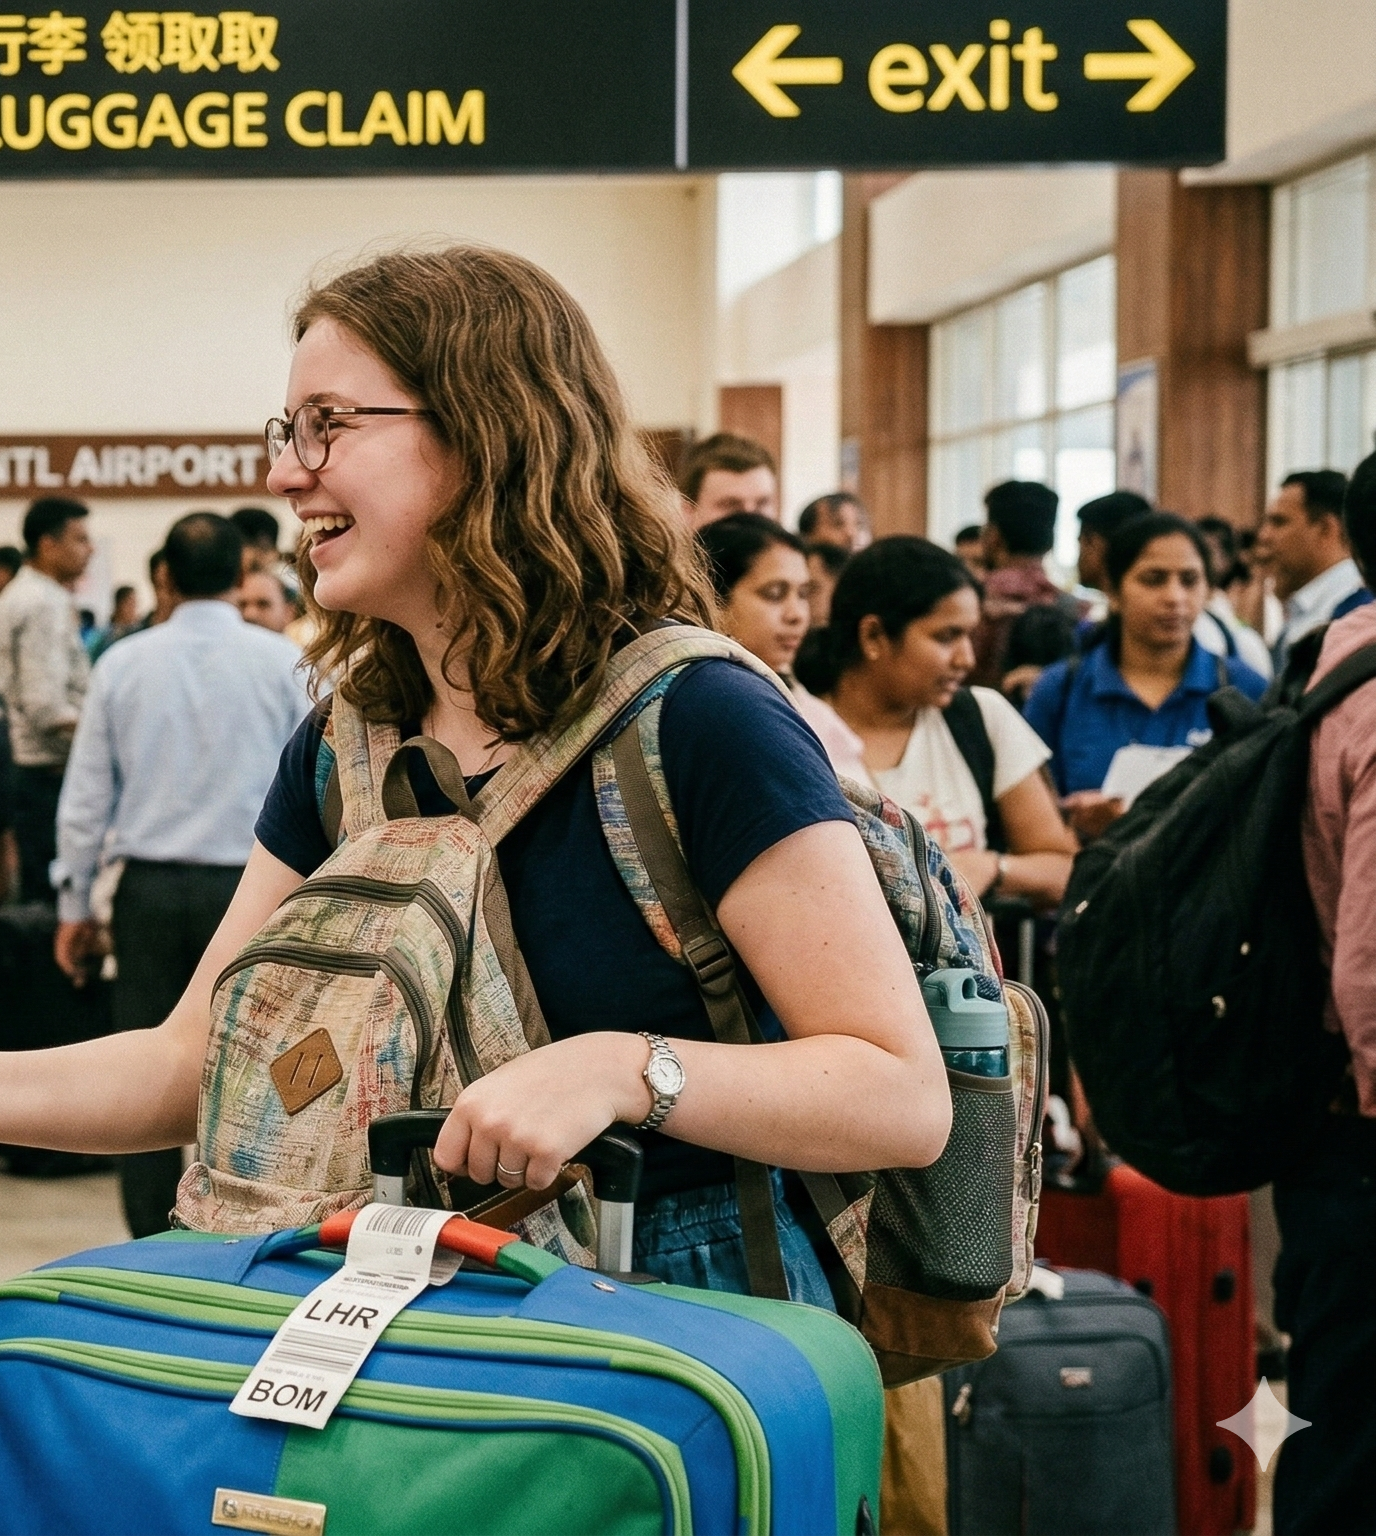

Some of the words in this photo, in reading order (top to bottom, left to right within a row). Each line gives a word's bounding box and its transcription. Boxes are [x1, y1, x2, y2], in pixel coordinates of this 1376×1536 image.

[868, 19, 1059, 113] exit
[284, 89, 485, 147] CLAIM
[67, 443, 265, 488] AIRPORT
[304, 1299, 380, 1330] LHR
[247, 1379, 328, 1413] BOM
